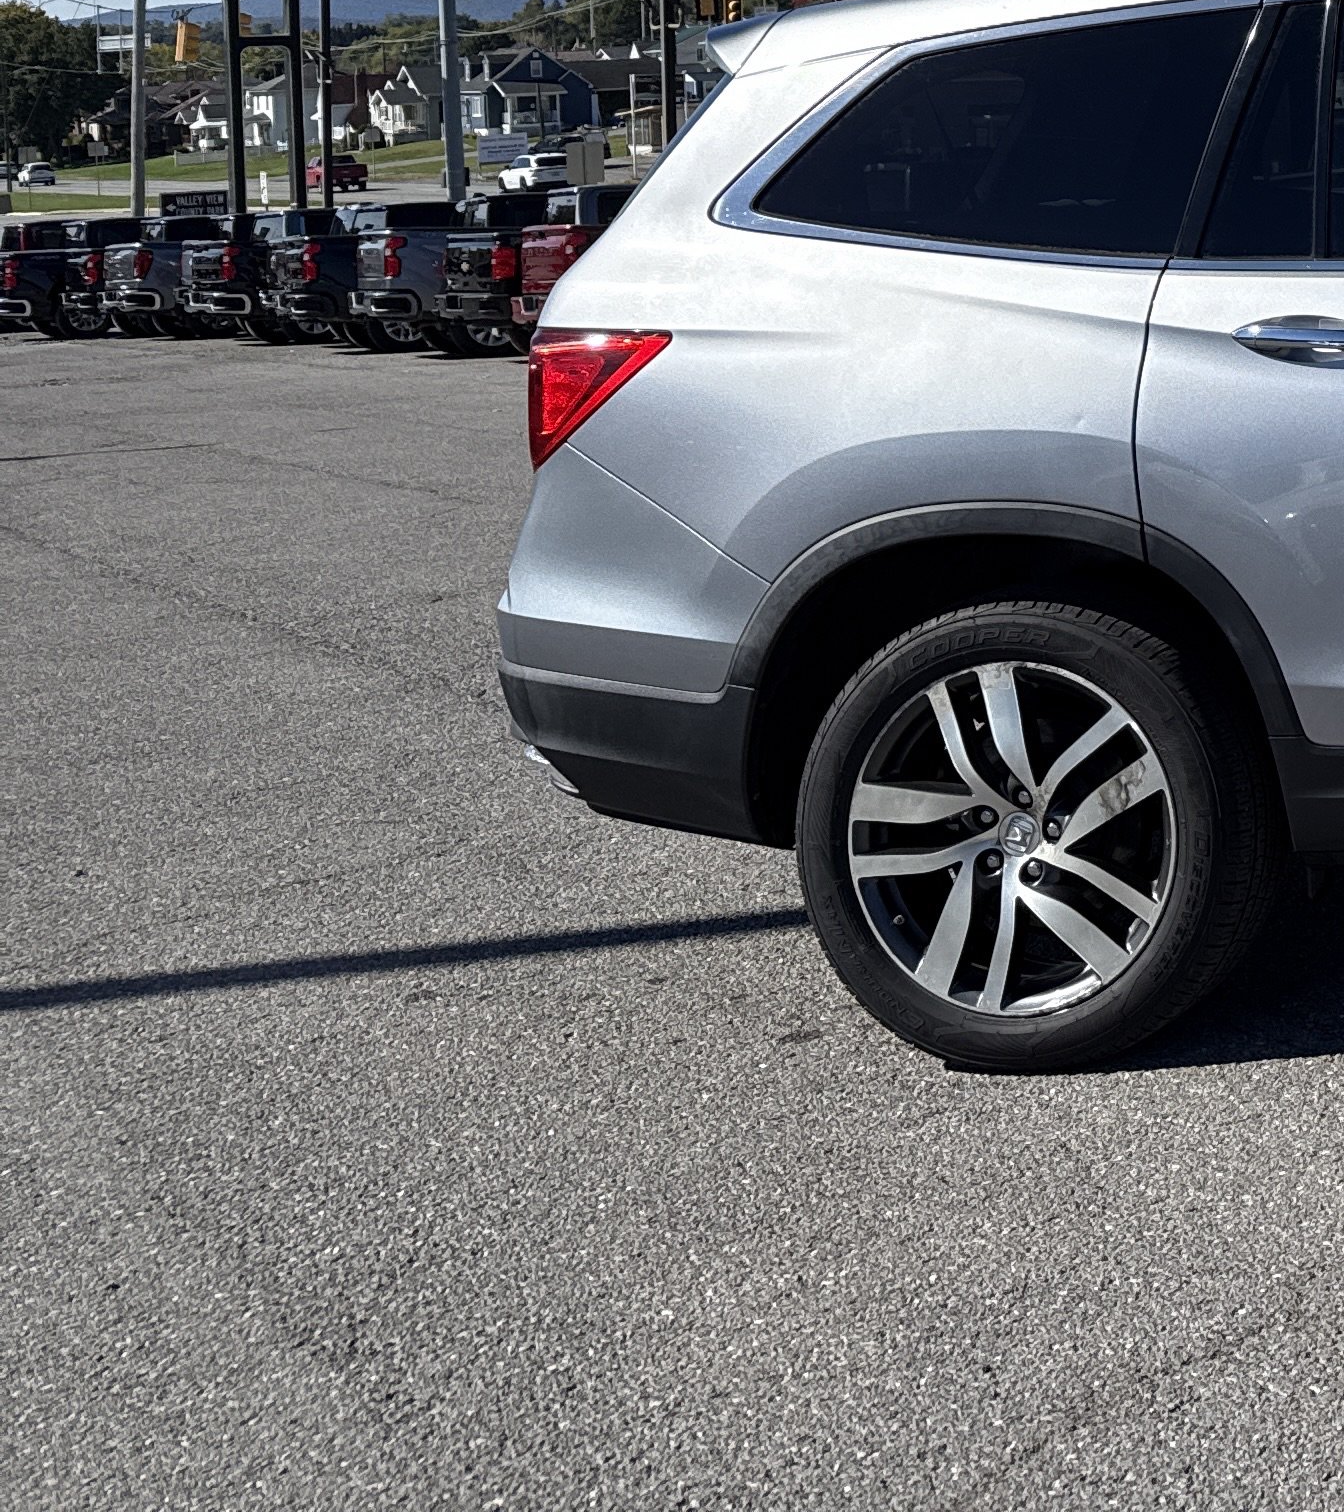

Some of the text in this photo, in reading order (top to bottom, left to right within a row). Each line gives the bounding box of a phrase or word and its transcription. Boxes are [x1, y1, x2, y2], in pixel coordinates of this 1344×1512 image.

[175, 193, 225, 206] VALLEY VIEW
[910, 627, 1051, 671] COOPER
